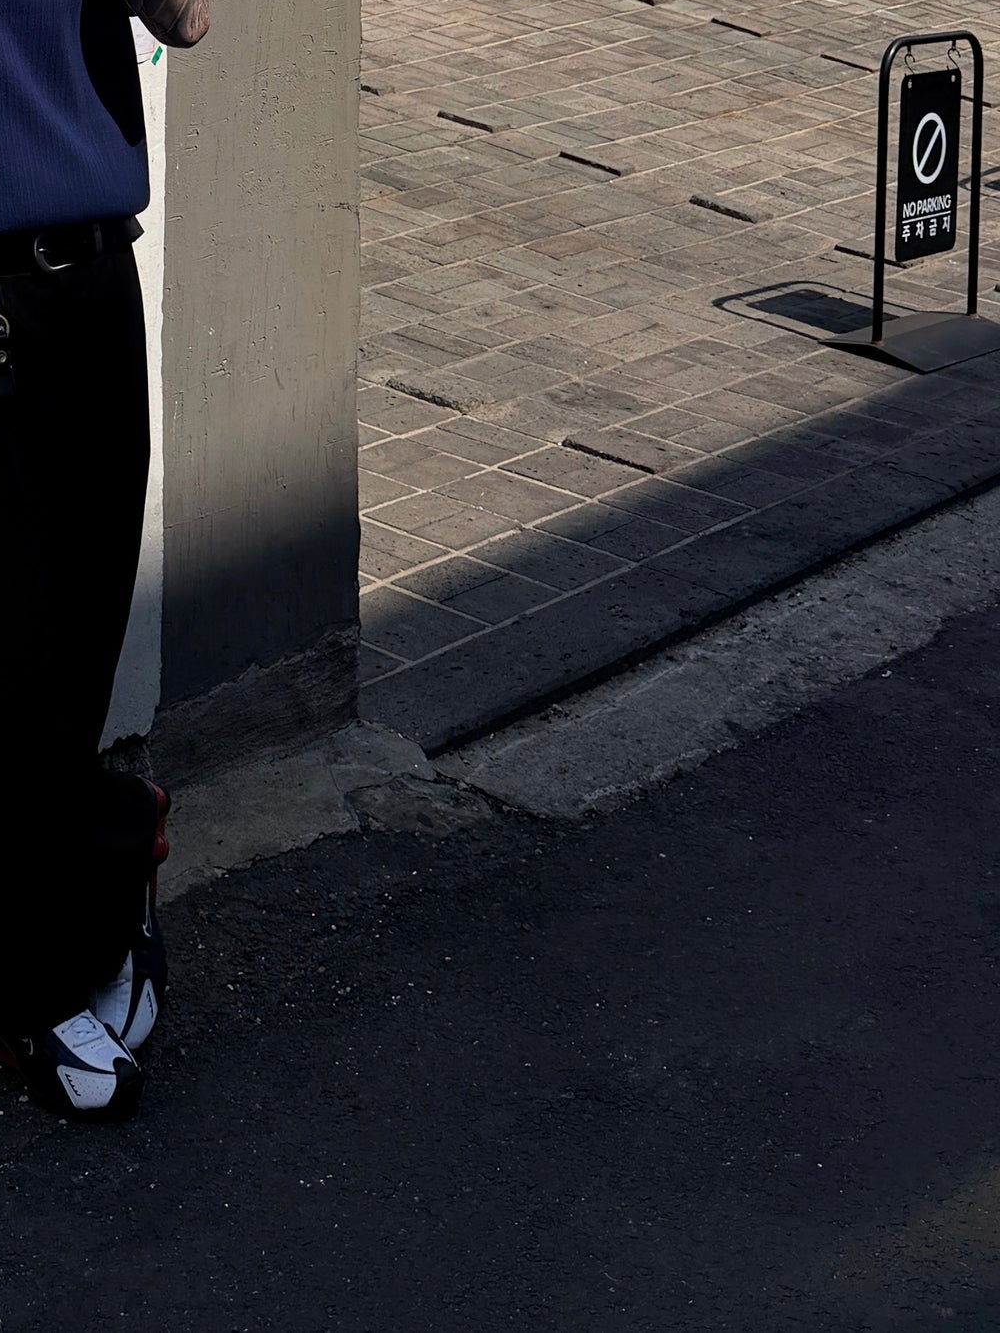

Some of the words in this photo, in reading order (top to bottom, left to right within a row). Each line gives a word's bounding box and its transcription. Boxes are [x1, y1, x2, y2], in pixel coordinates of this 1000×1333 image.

[902, 202, 916, 218] NO
[917, 194, 951, 215] PARKING
[902, 215, 950, 242] 주차금지
